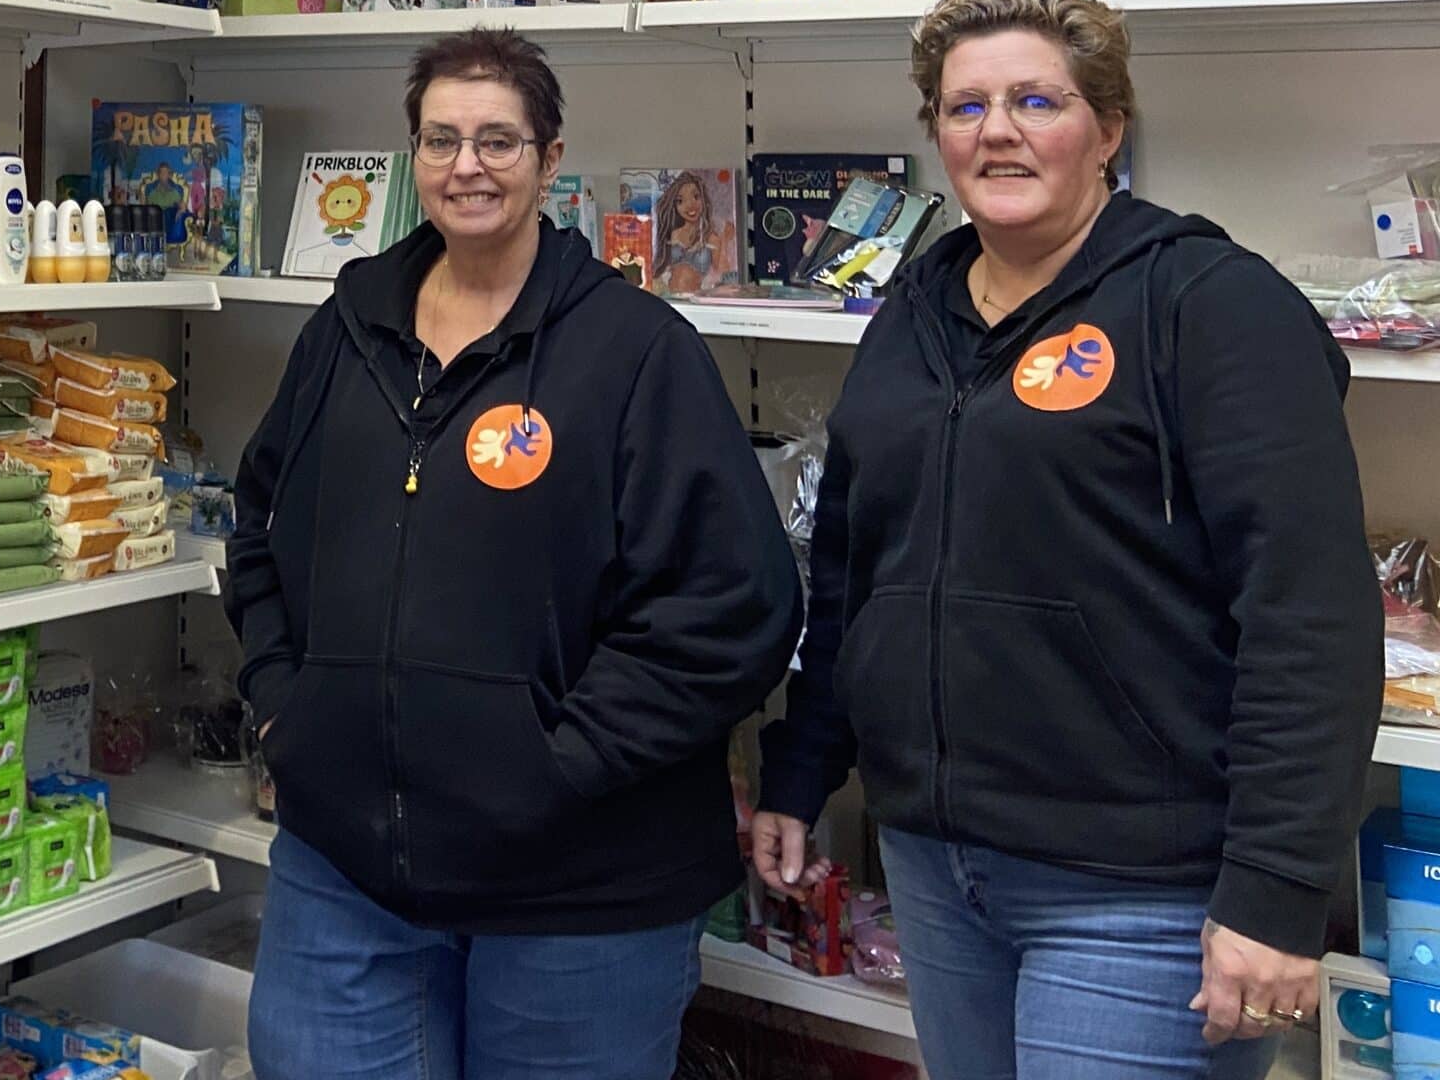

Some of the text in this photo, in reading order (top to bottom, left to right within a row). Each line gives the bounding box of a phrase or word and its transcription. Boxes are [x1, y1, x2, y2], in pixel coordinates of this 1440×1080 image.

[113, 111, 216, 147] PASHA
[313, 156, 388, 172] PRIKBLOK
[764, 169, 833, 190] GLOW
[766, 188, 831, 201] IN THE DARK
